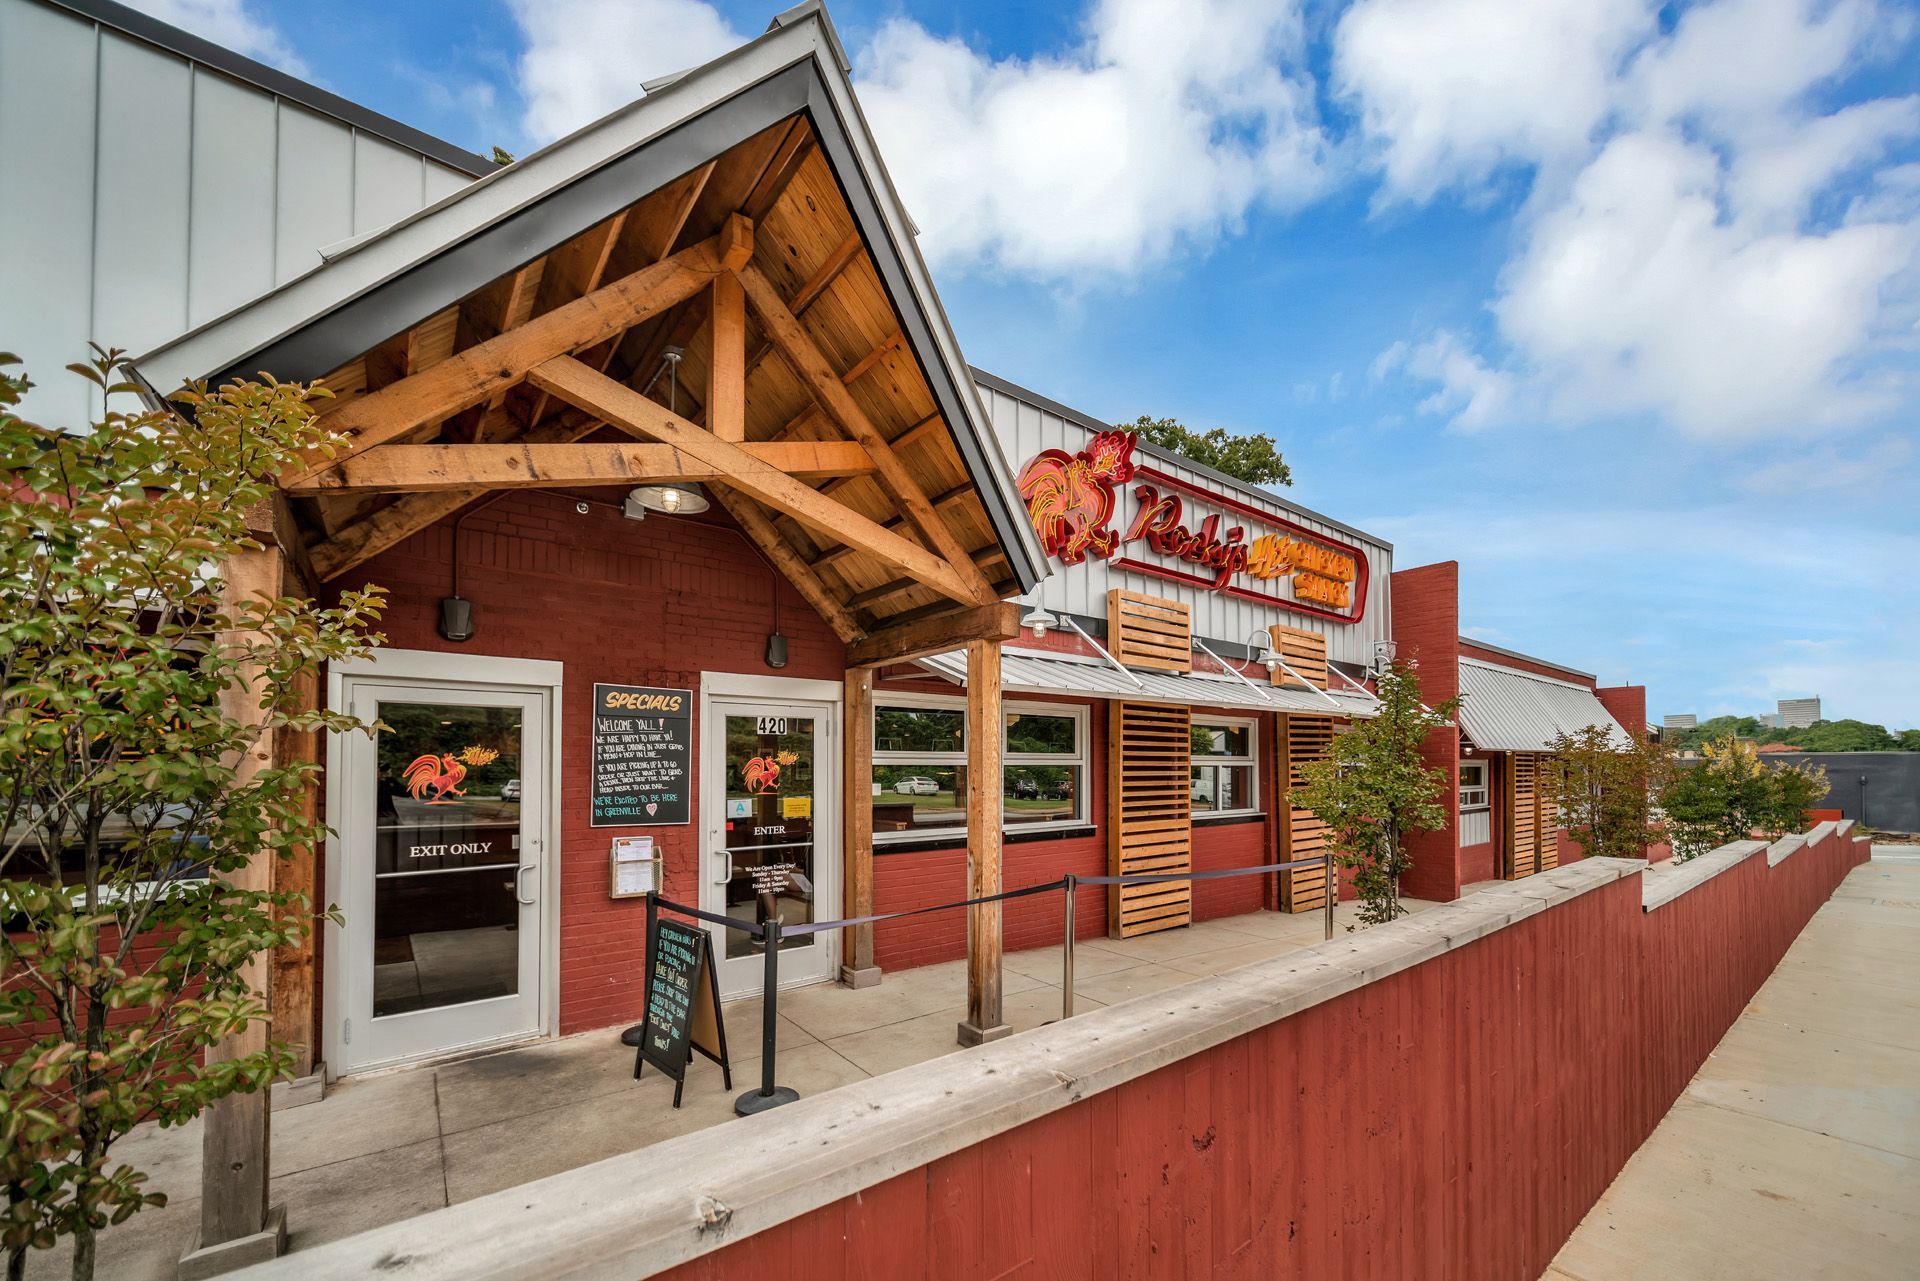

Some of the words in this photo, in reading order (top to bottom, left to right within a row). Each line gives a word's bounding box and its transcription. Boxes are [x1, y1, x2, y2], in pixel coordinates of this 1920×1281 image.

[1288, 542, 1355, 582] CHICKEN
[1293, 573, 1350, 608] SHACK
[606, 692, 682, 711] SPECIALS
[598, 718, 633, 731] WELCOME
[758, 718, 786, 734] 420
[623, 734, 638, 742] HAPPY
[640, 734, 648, 742] TO
[616, 744, 624, 752] ARE
[627, 743, 645, 751] DINING
[605, 764, 616, 772] YOU
[617, 763, 627, 771] ARE
[629, 762, 649, 770] PICKING
[598, 773, 616, 781] ORDER
[594, 796, 613, 805] WE'RE
[614, 796, 638, 804] EXCITED
[639, 795, 648, 803] TO
[651, 794, 660, 802] BE
[605, 807, 640, 817] GREENVILLE
[736, 803, 745, 812] A
[754, 826, 786, 836] ENTER
[410, 845, 448, 857] EXIT
[450, 842, 492, 855] ONLY
[663, 940, 671, 952] YOU
[658, 951, 664, 960] OR
[682, 963, 686, 972] A
[656, 961, 667, 976] TAKE
[667, 967, 676, 981] OUT
[675, 973, 688, 989] ORDER
